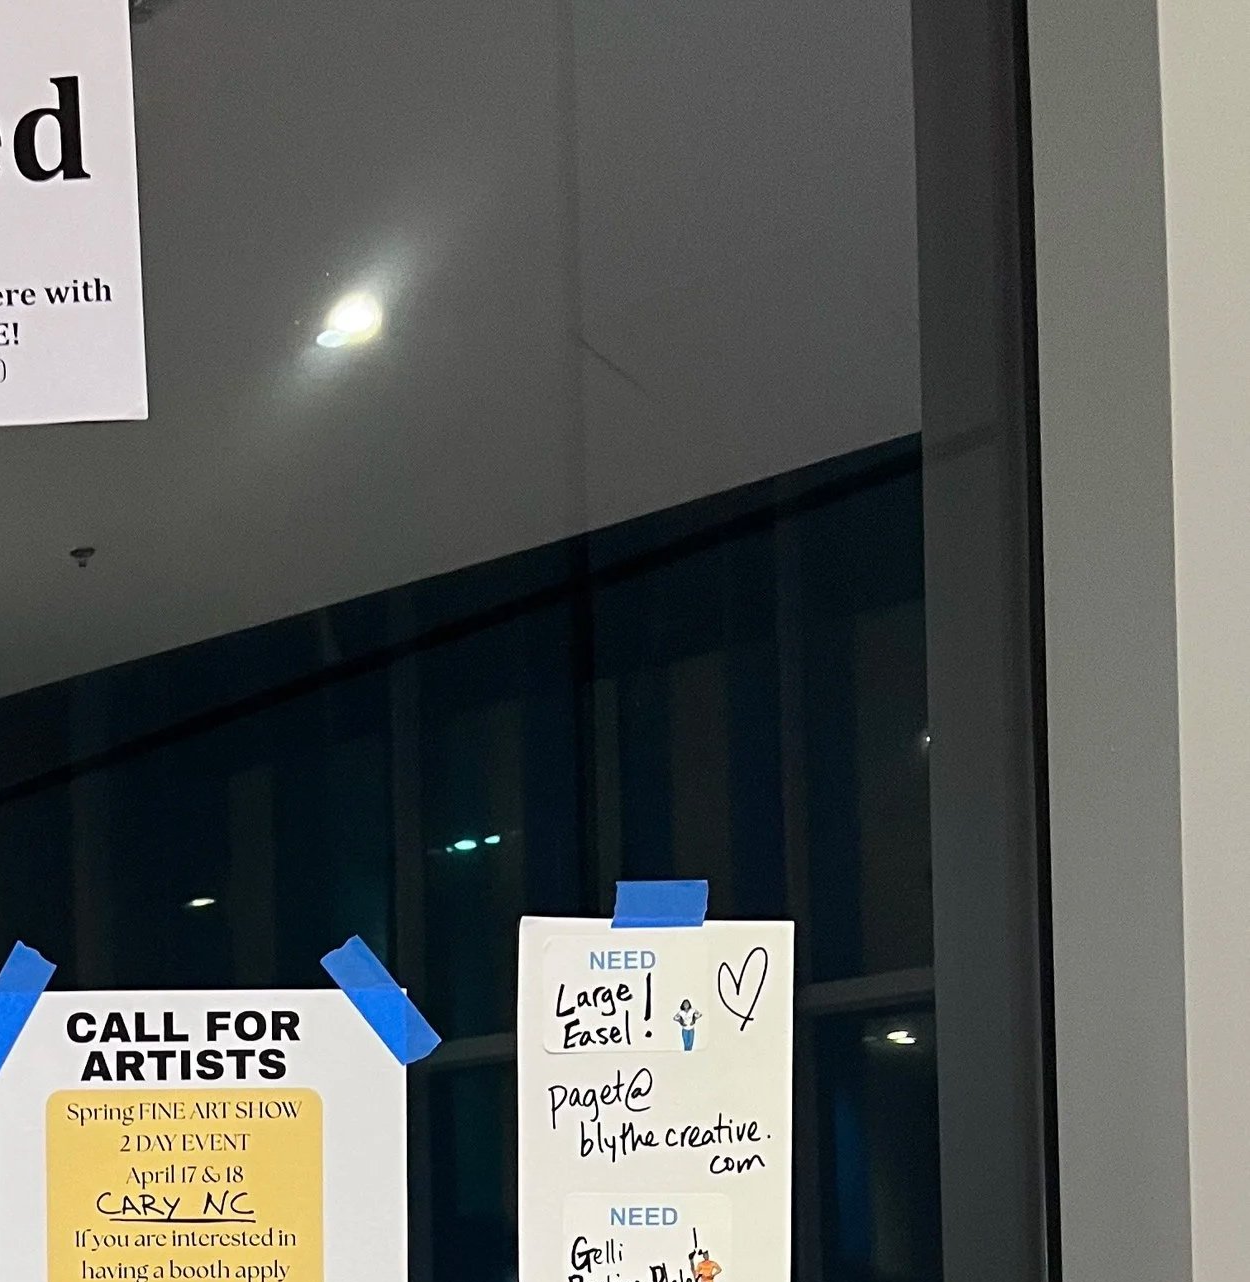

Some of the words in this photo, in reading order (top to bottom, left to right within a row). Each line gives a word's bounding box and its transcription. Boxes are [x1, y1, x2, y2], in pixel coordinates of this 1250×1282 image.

[45, 278, 111, 304] with
[590, 951, 655, 969] NEED
[556, 984, 632, 1017] Large
[67, 1012, 188, 1043] CALL
[207, 1011, 300, 1041] FOR
[564, 1017, 631, 1049] Easel
[81, 1049, 286, 1081] ARTISTS
[548, 1068, 652, 1127] paget@
[710, 1155, 765, 1174] com
[97, 1192, 181, 1218] CARY
[204, 1192, 254, 1215] NC
[611, 1208, 677, 1225] NEED
[571, 1236, 623, 1270] Gelli
